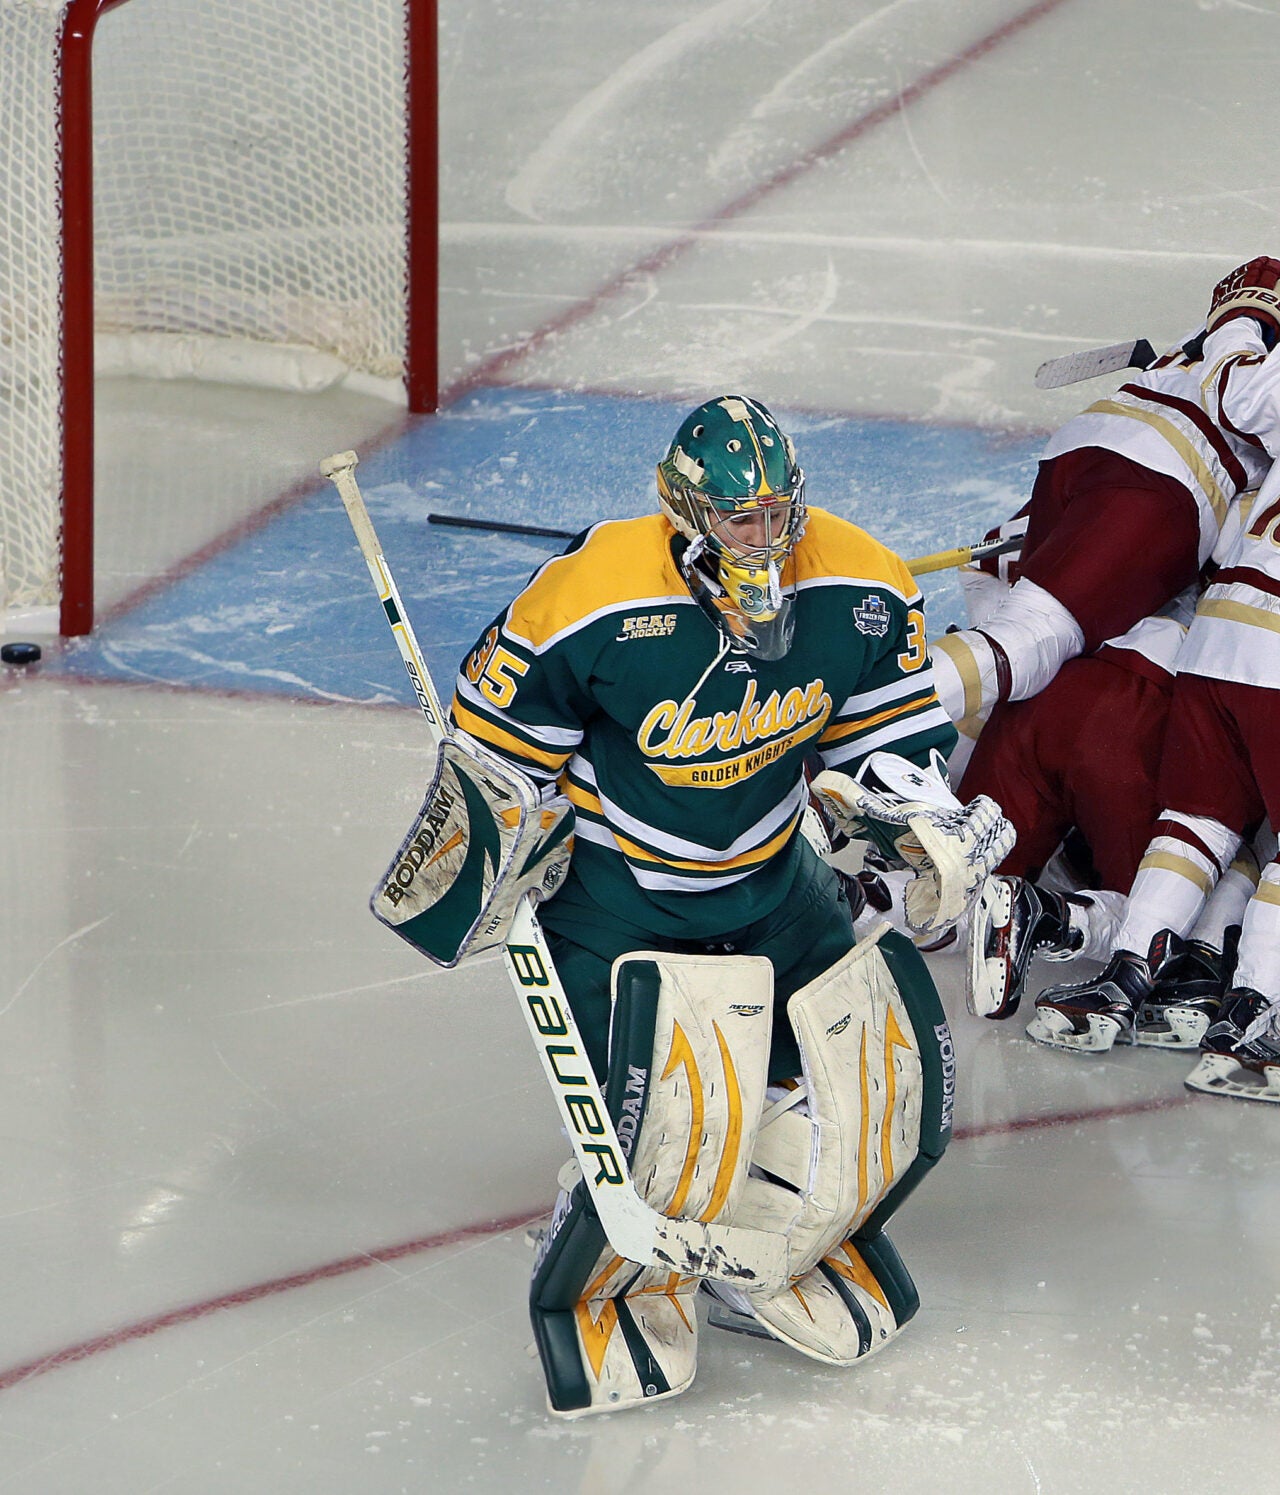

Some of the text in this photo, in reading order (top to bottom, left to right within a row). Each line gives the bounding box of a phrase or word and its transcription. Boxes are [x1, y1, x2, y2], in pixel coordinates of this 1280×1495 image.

[622, 613, 677, 631] ECAC
[629, 627, 675, 639] HOCKEY
[404, 660, 437, 725] 9000
[465, 626, 531, 708] 35
[636, 678, 832, 759] Clarkson
[691, 736, 795, 783] GOLDEN KNIGHTS
[383, 787, 455, 908] BODDAM
[484, 914, 503, 937] TILEY
[617, 1064, 647, 1158] DDAM
[933, 1021, 957, 1133] BODDAM
